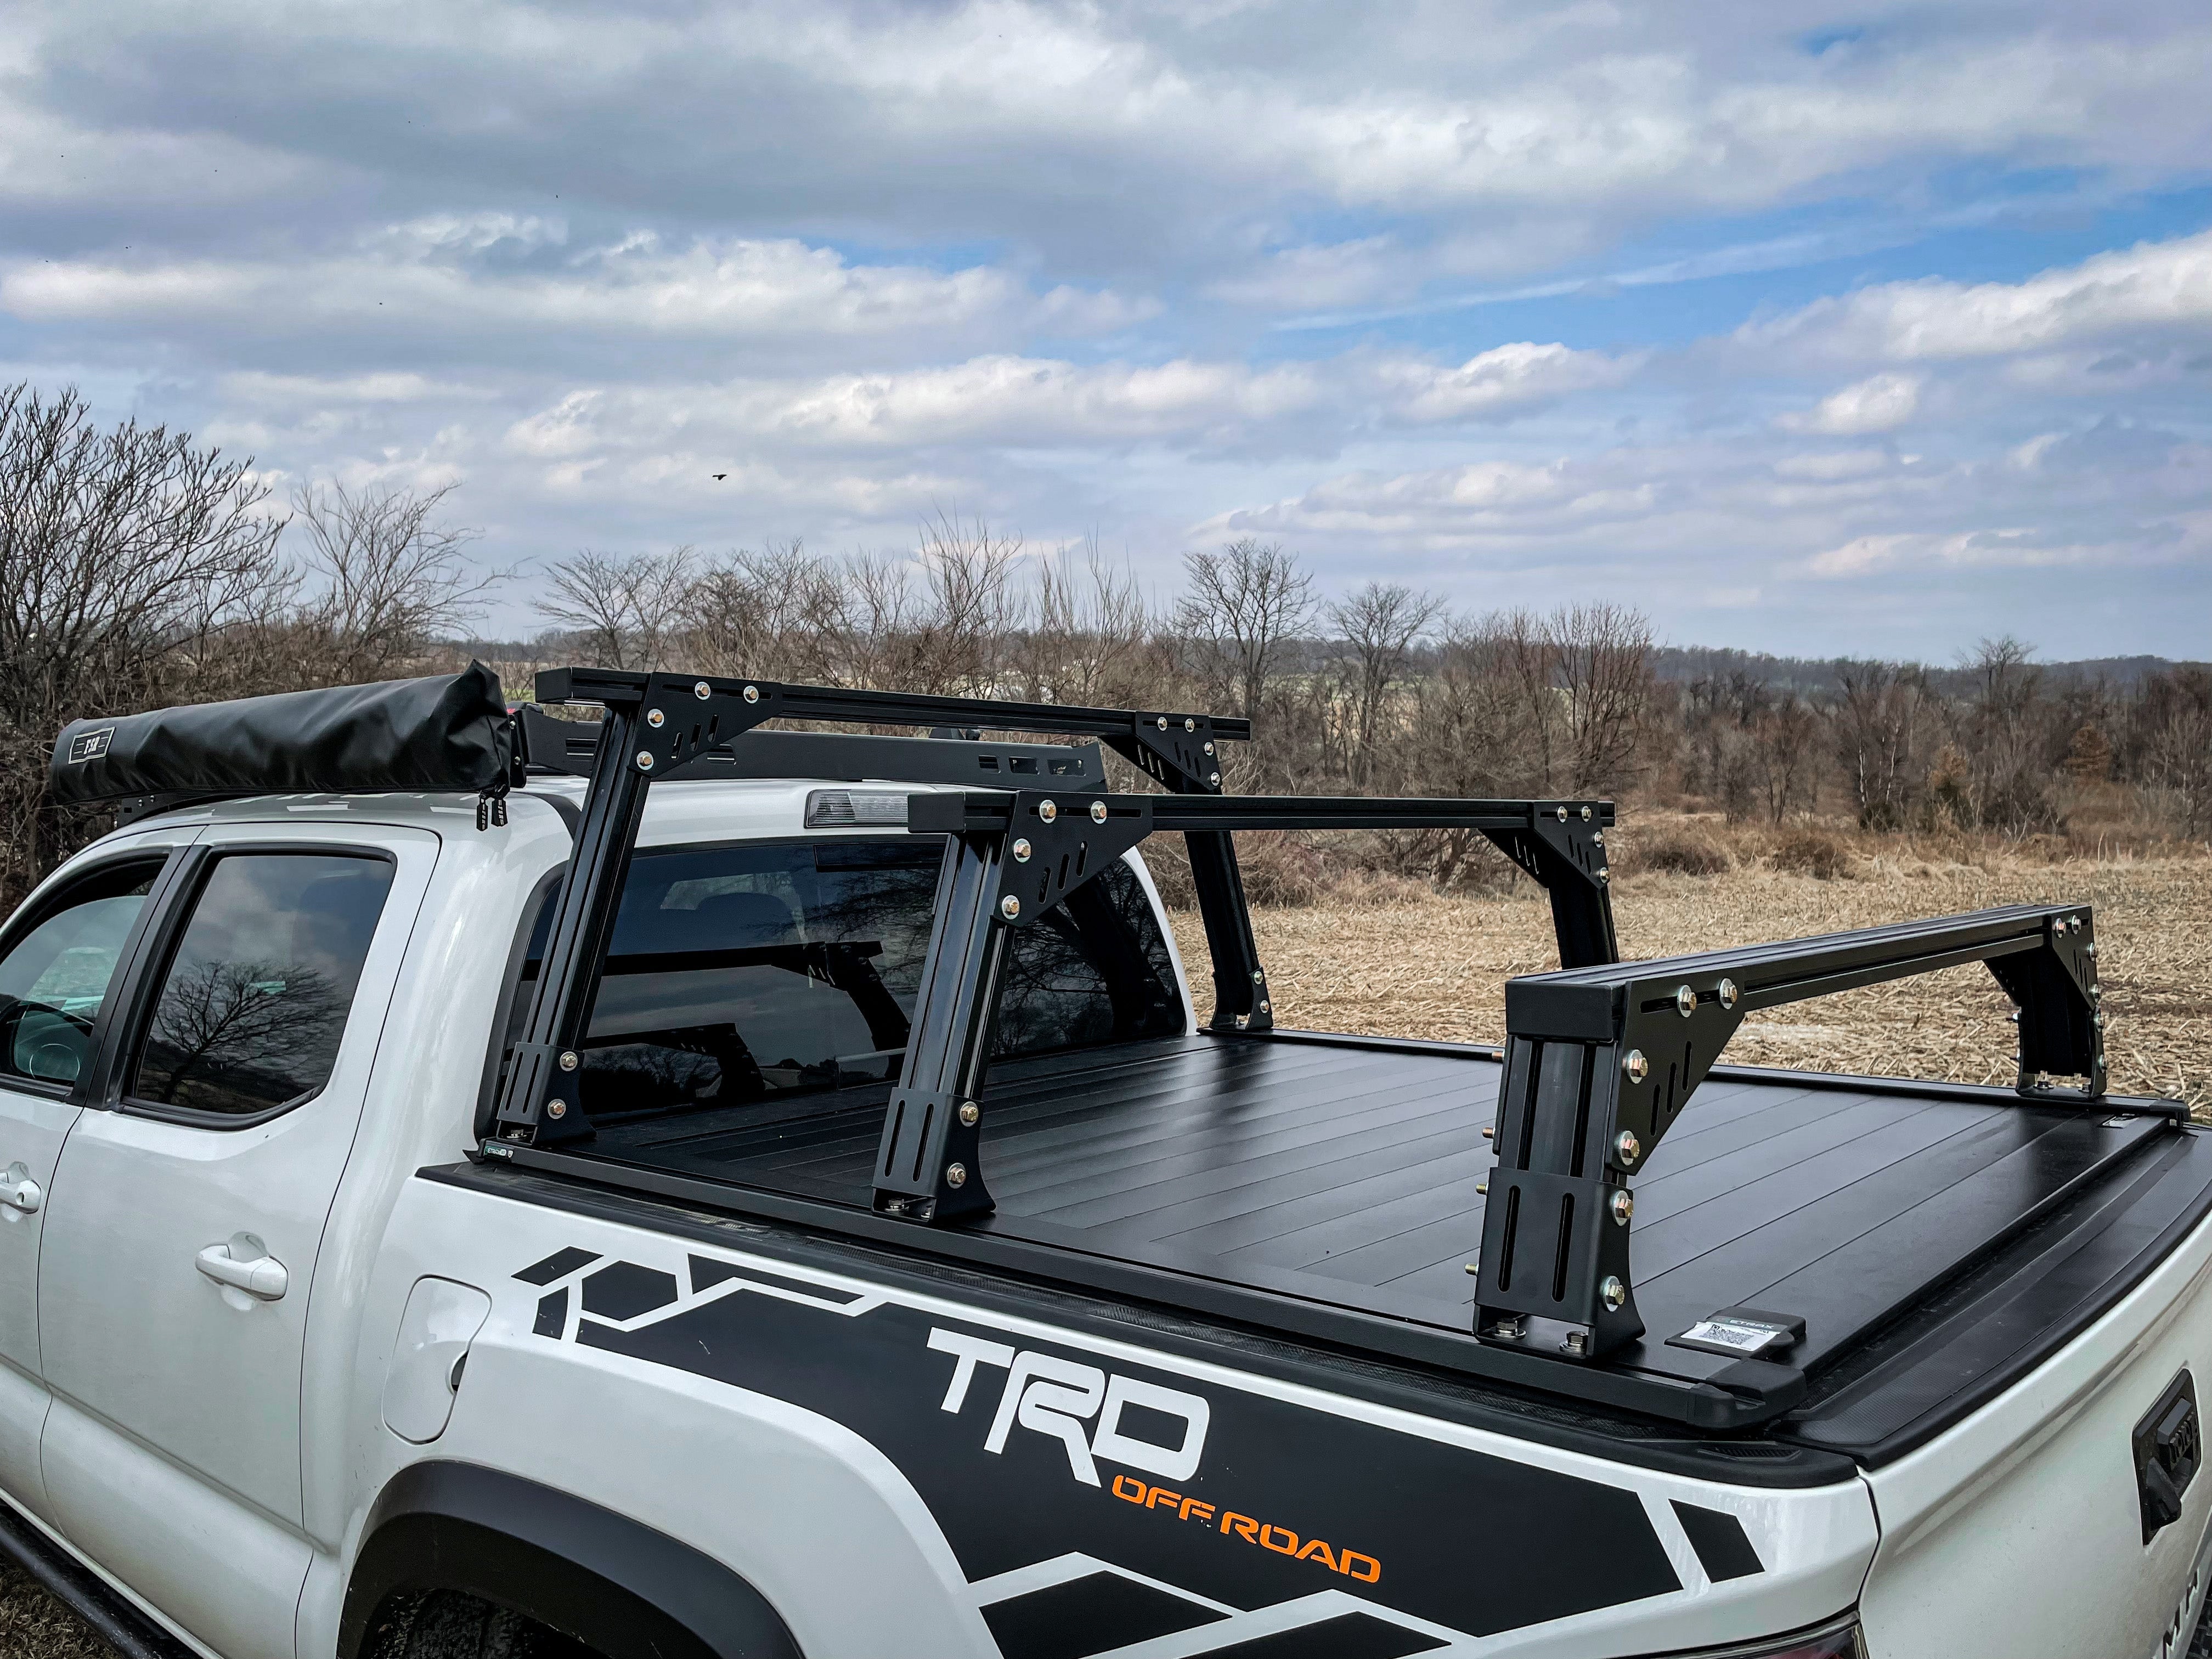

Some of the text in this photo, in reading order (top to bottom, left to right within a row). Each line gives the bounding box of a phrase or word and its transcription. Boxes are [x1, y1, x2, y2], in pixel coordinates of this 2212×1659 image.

[926, 1327, 1210, 1488] TRD
[1111, 1474, 1381, 1583] OFF ROAD
